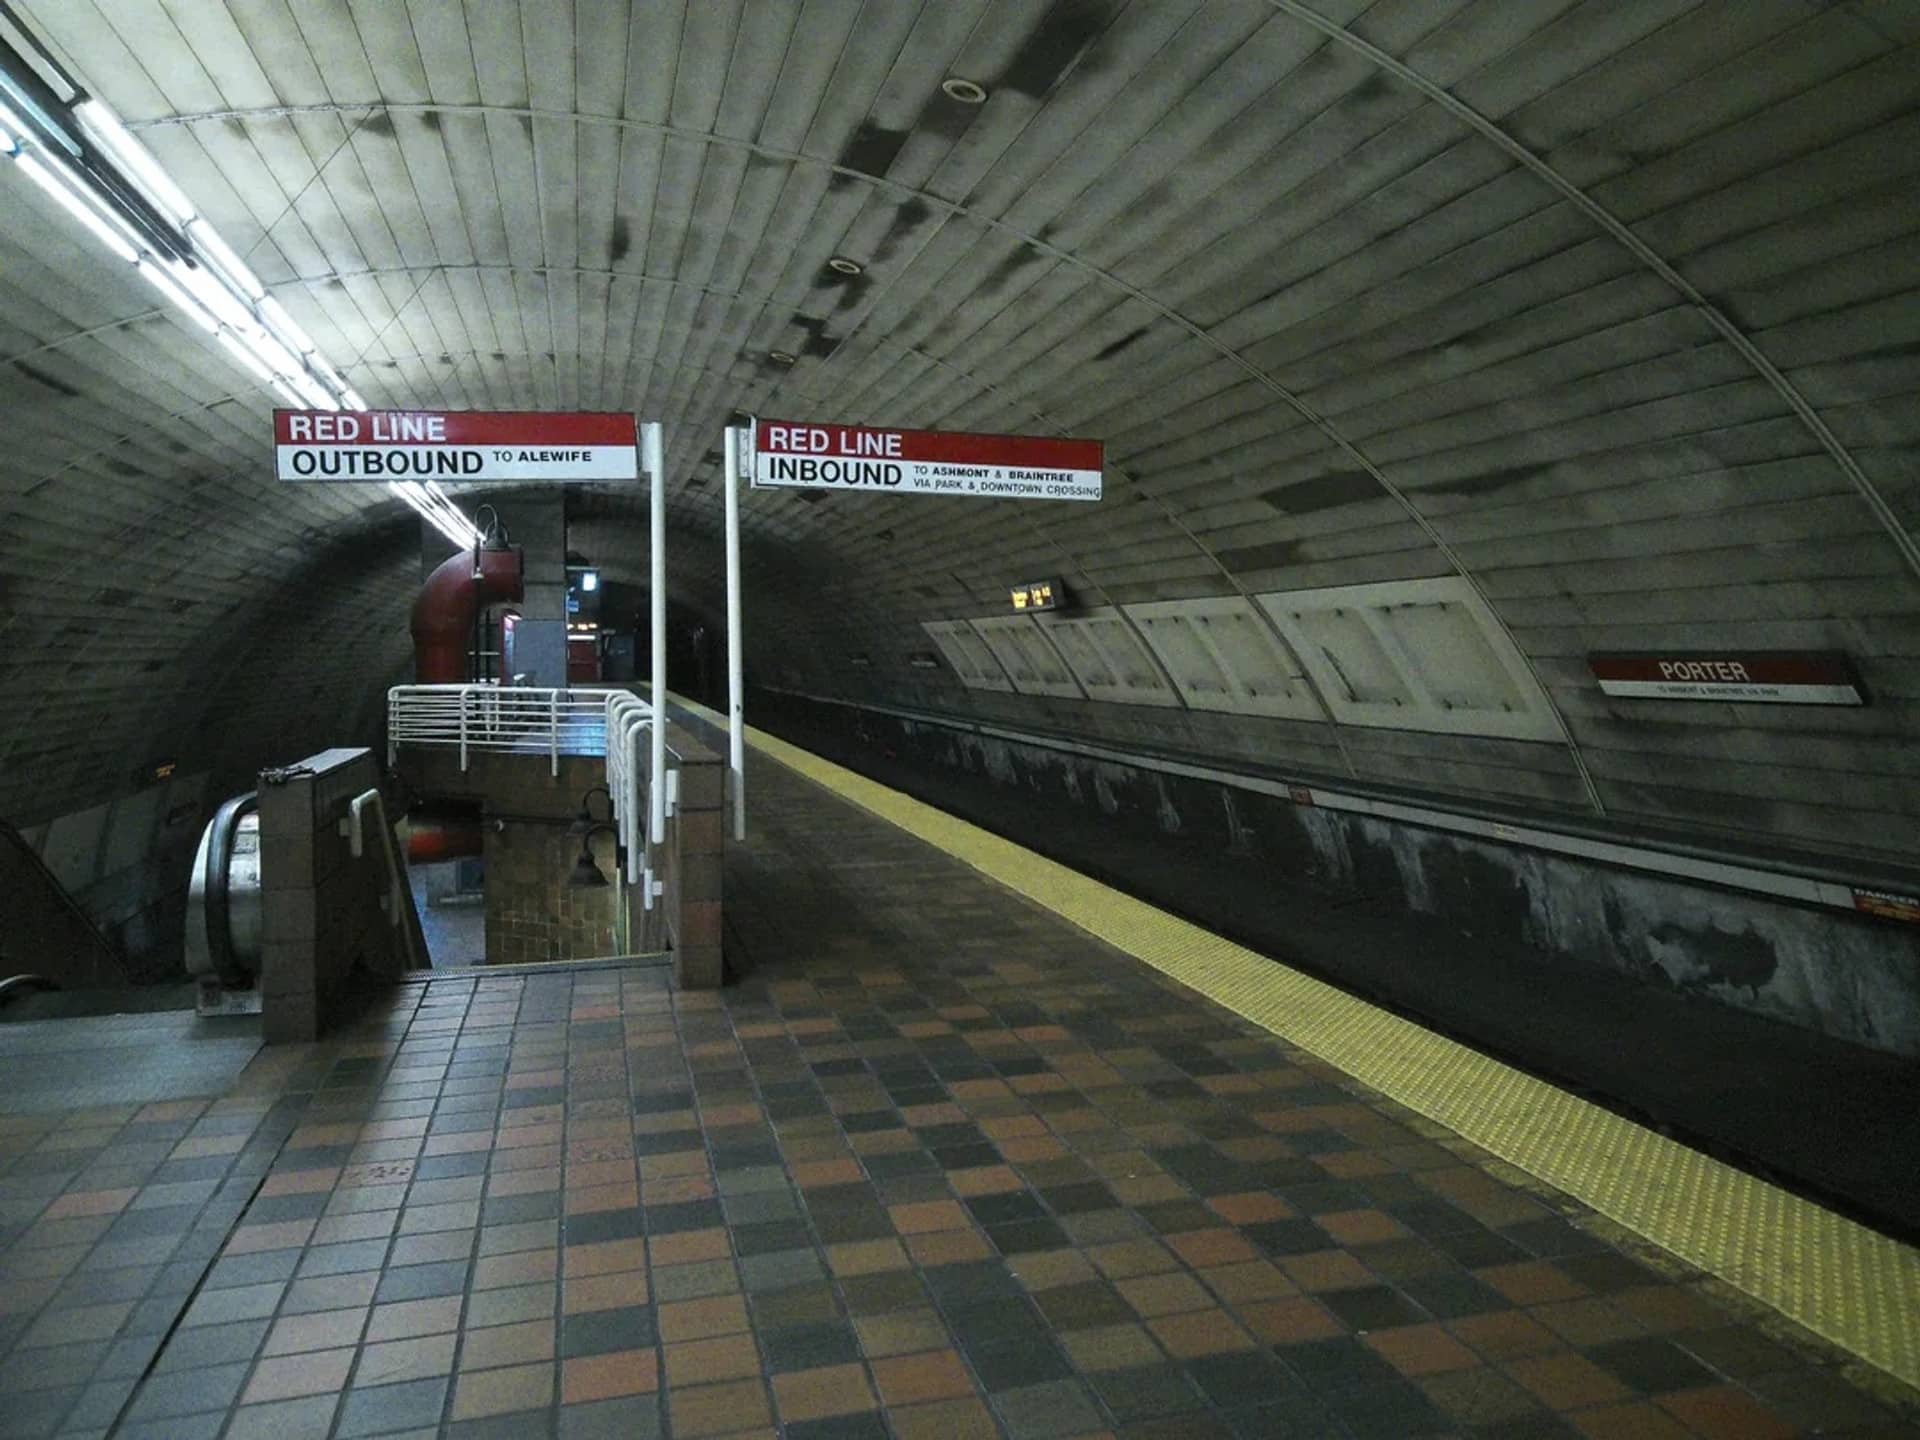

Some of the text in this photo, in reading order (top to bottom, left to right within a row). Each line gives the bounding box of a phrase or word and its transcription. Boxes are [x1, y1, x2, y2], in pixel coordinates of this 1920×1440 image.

[289, 415, 446, 441] RED LINE
[769, 427, 902, 457] RED LINE
[293, 450, 592, 475] OUTBOUND TO ALEWIFE
[769, 457, 902, 485] INBOUND
[914, 465, 1073, 482] TO ASHMONT & BRAINTREE
[914, 479, 1100, 498] VIA PARK & DOWNTOWN CROSSING
[1658, 661, 1750, 681] PORTER
